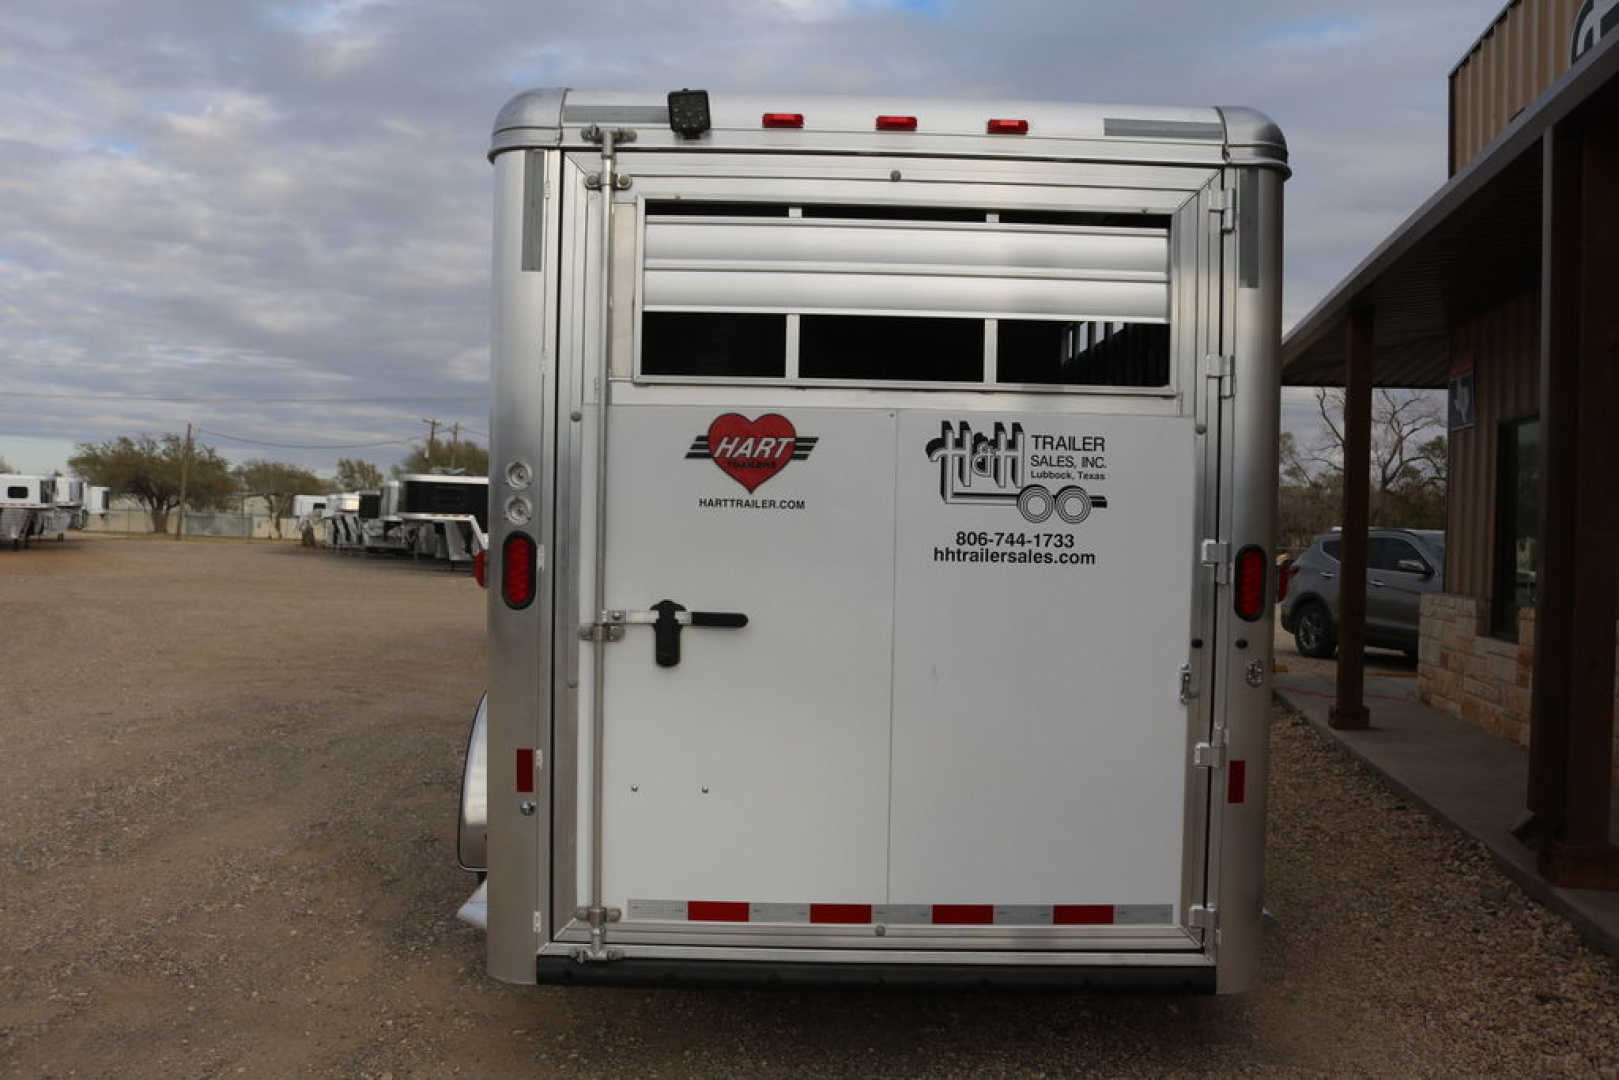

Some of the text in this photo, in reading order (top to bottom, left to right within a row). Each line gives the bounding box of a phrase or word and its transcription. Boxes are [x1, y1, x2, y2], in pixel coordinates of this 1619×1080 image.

[713, 437, 796, 458] HART
[1031, 434, 1106, 452] TRAILER
[1030, 454, 1107, 469] SALES, INC.
[1030, 470, 1106, 481] Lubbock, Texas
[698, 497, 806, 510] HARTTRAILER.COM
[956, 531, 1075, 548] 806-744-1733
[933, 546, 1096, 565] hhtrailersales.com
